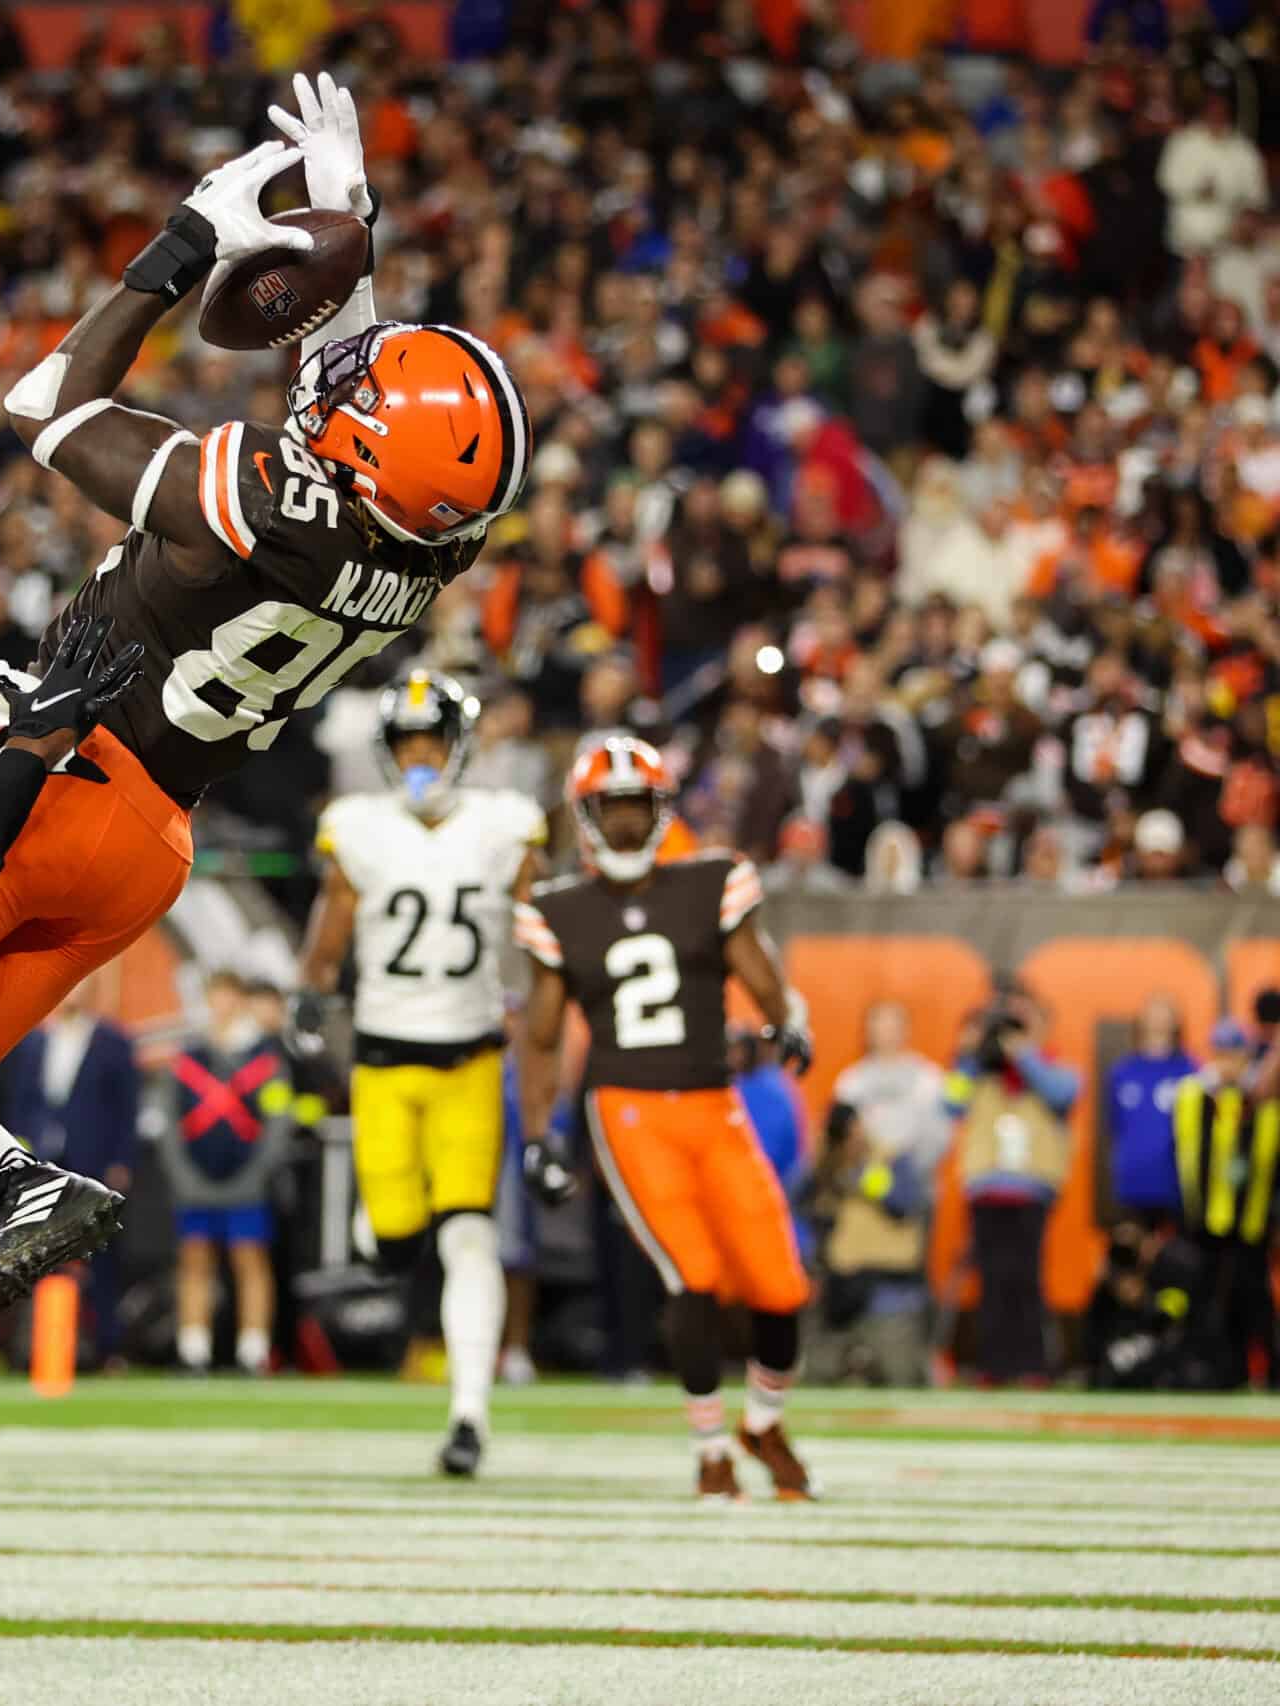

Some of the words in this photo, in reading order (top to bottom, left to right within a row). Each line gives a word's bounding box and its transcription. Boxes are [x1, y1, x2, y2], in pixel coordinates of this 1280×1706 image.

[253, 273, 287, 303] NFL
[279, 437, 339, 528] 85
[385, 886, 483, 979] 25
[604, 933, 686, 1049] 2
